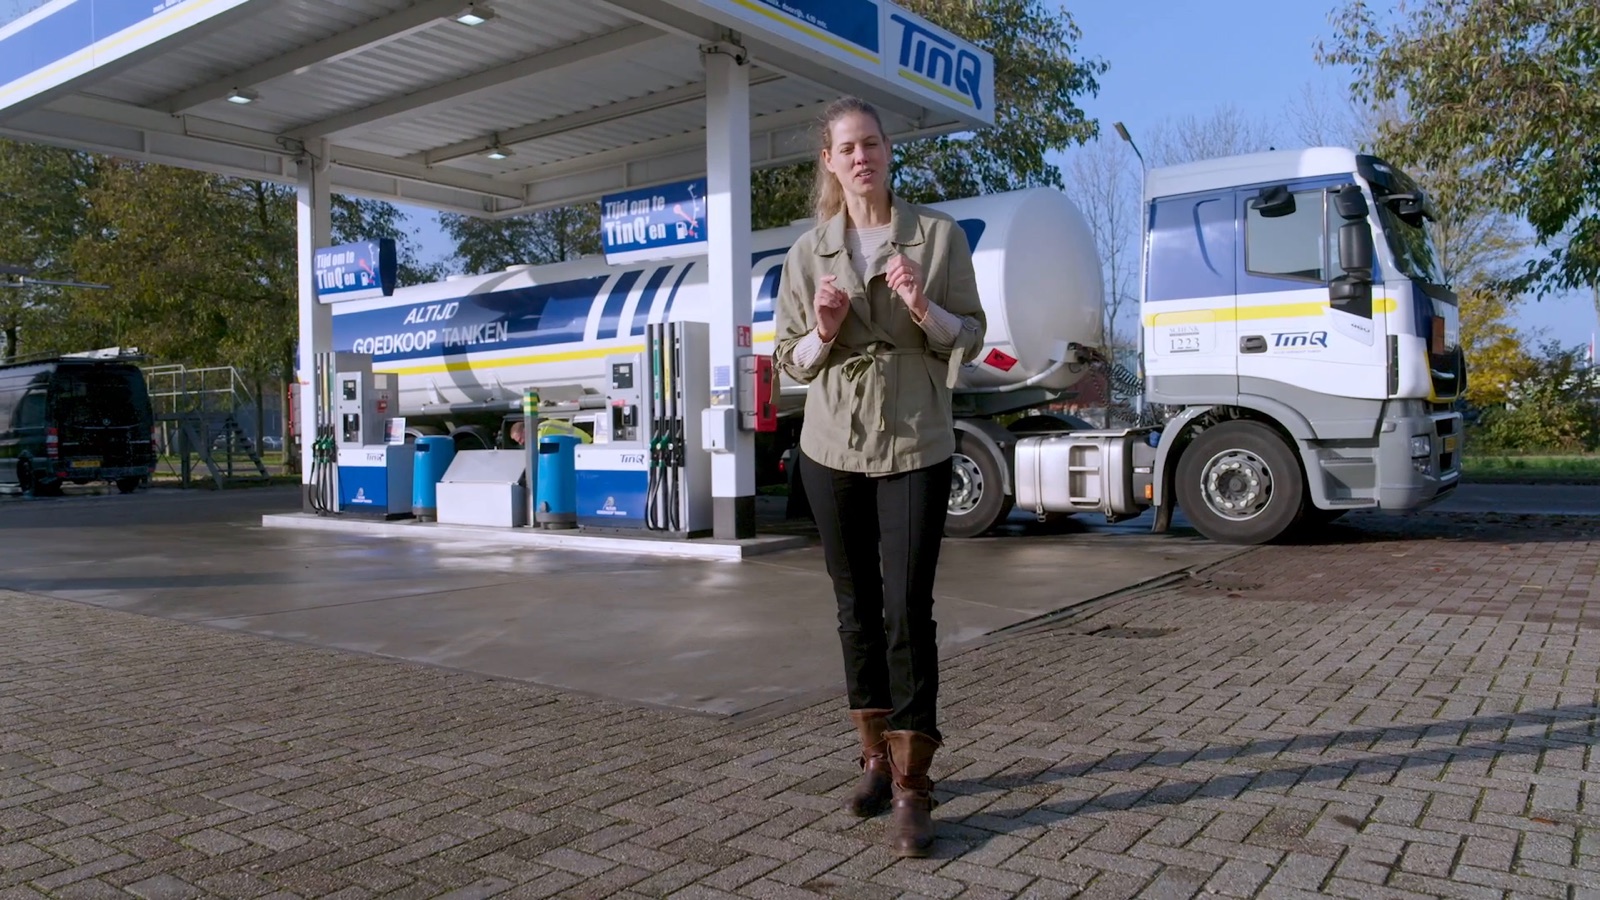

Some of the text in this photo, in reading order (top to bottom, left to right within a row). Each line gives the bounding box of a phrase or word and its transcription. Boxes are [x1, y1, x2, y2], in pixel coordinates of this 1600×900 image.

[890, 13, 982, 110] TinQ
[605, 196, 665, 219] Tijd om te
[605, 216, 667, 246] TinQ'en
[317, 251, 355, 268] Tijd om te
[403, 302, 460, 325] ALTIJD
[353, 321, 509, 355] GOEDKOOP TANKEN
[1170, 338, 1200, 350] 1223
[1270, 331, 1328, 348] TinQ
[620, 454, 645, 465] TinQ
